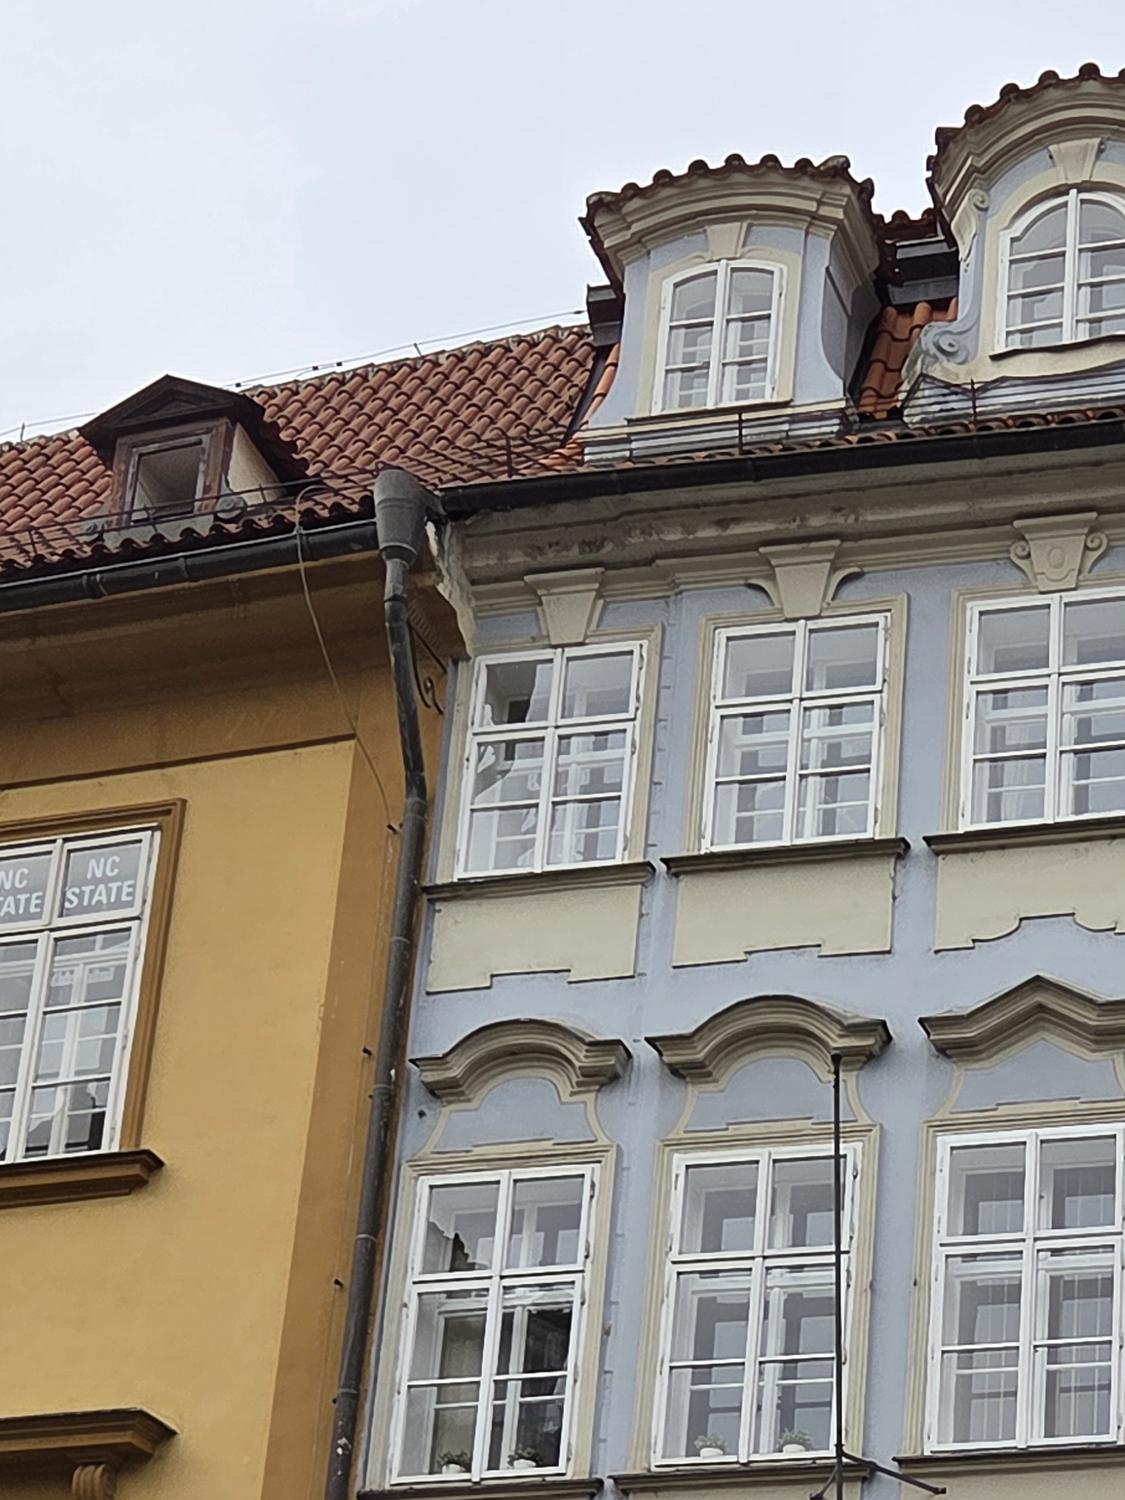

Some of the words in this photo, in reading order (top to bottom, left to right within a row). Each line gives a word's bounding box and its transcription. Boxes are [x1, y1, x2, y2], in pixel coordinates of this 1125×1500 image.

[86, 855, 121, 880] NC
[0, 891, 43, 917] ATE
[64, 880, 136, 909] STATE
